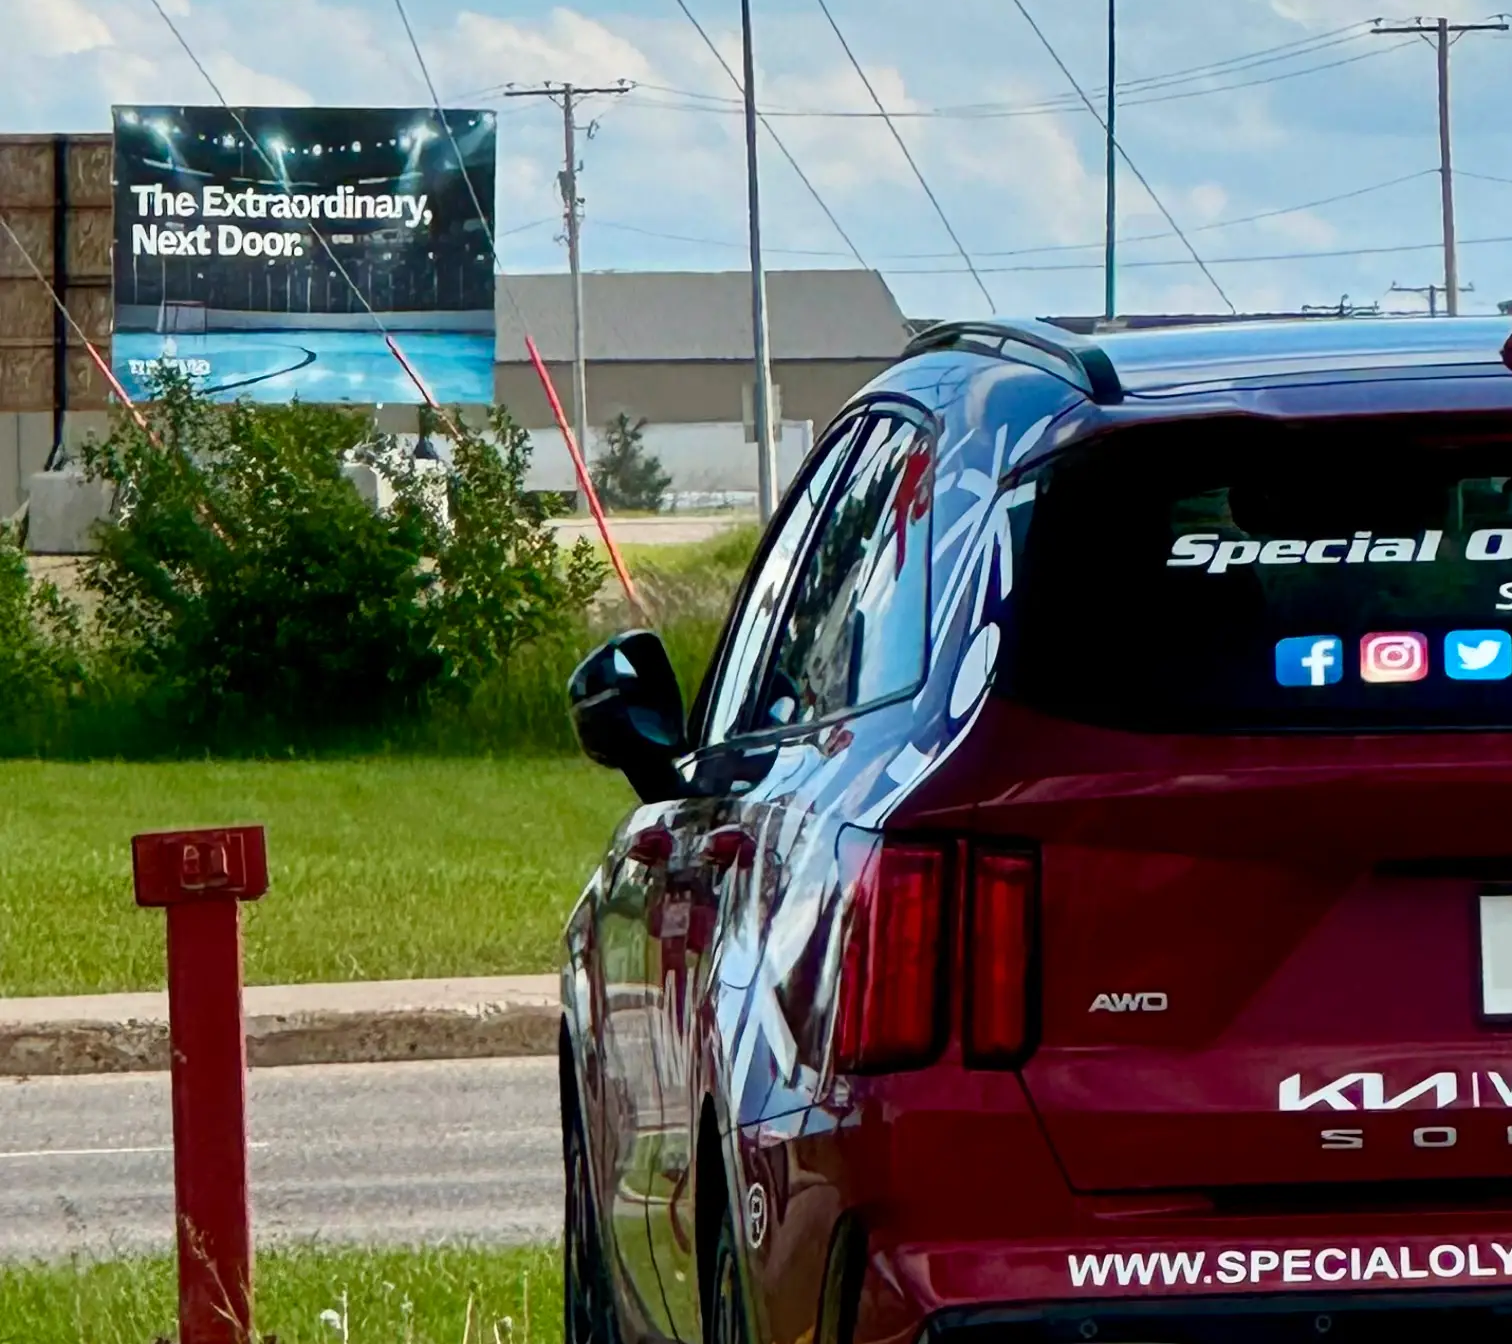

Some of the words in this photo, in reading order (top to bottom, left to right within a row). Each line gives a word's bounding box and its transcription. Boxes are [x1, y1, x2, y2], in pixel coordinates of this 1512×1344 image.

[130, 183, 199, 217] The
[202, 184, 433, 228] Extraordinary,
[131, 223, 212, 256] Next
[217, 224, 304, 257] Door.
[1165, 529, 1444, 574] Special
[1087, 991, 1168, 1013] AWD
